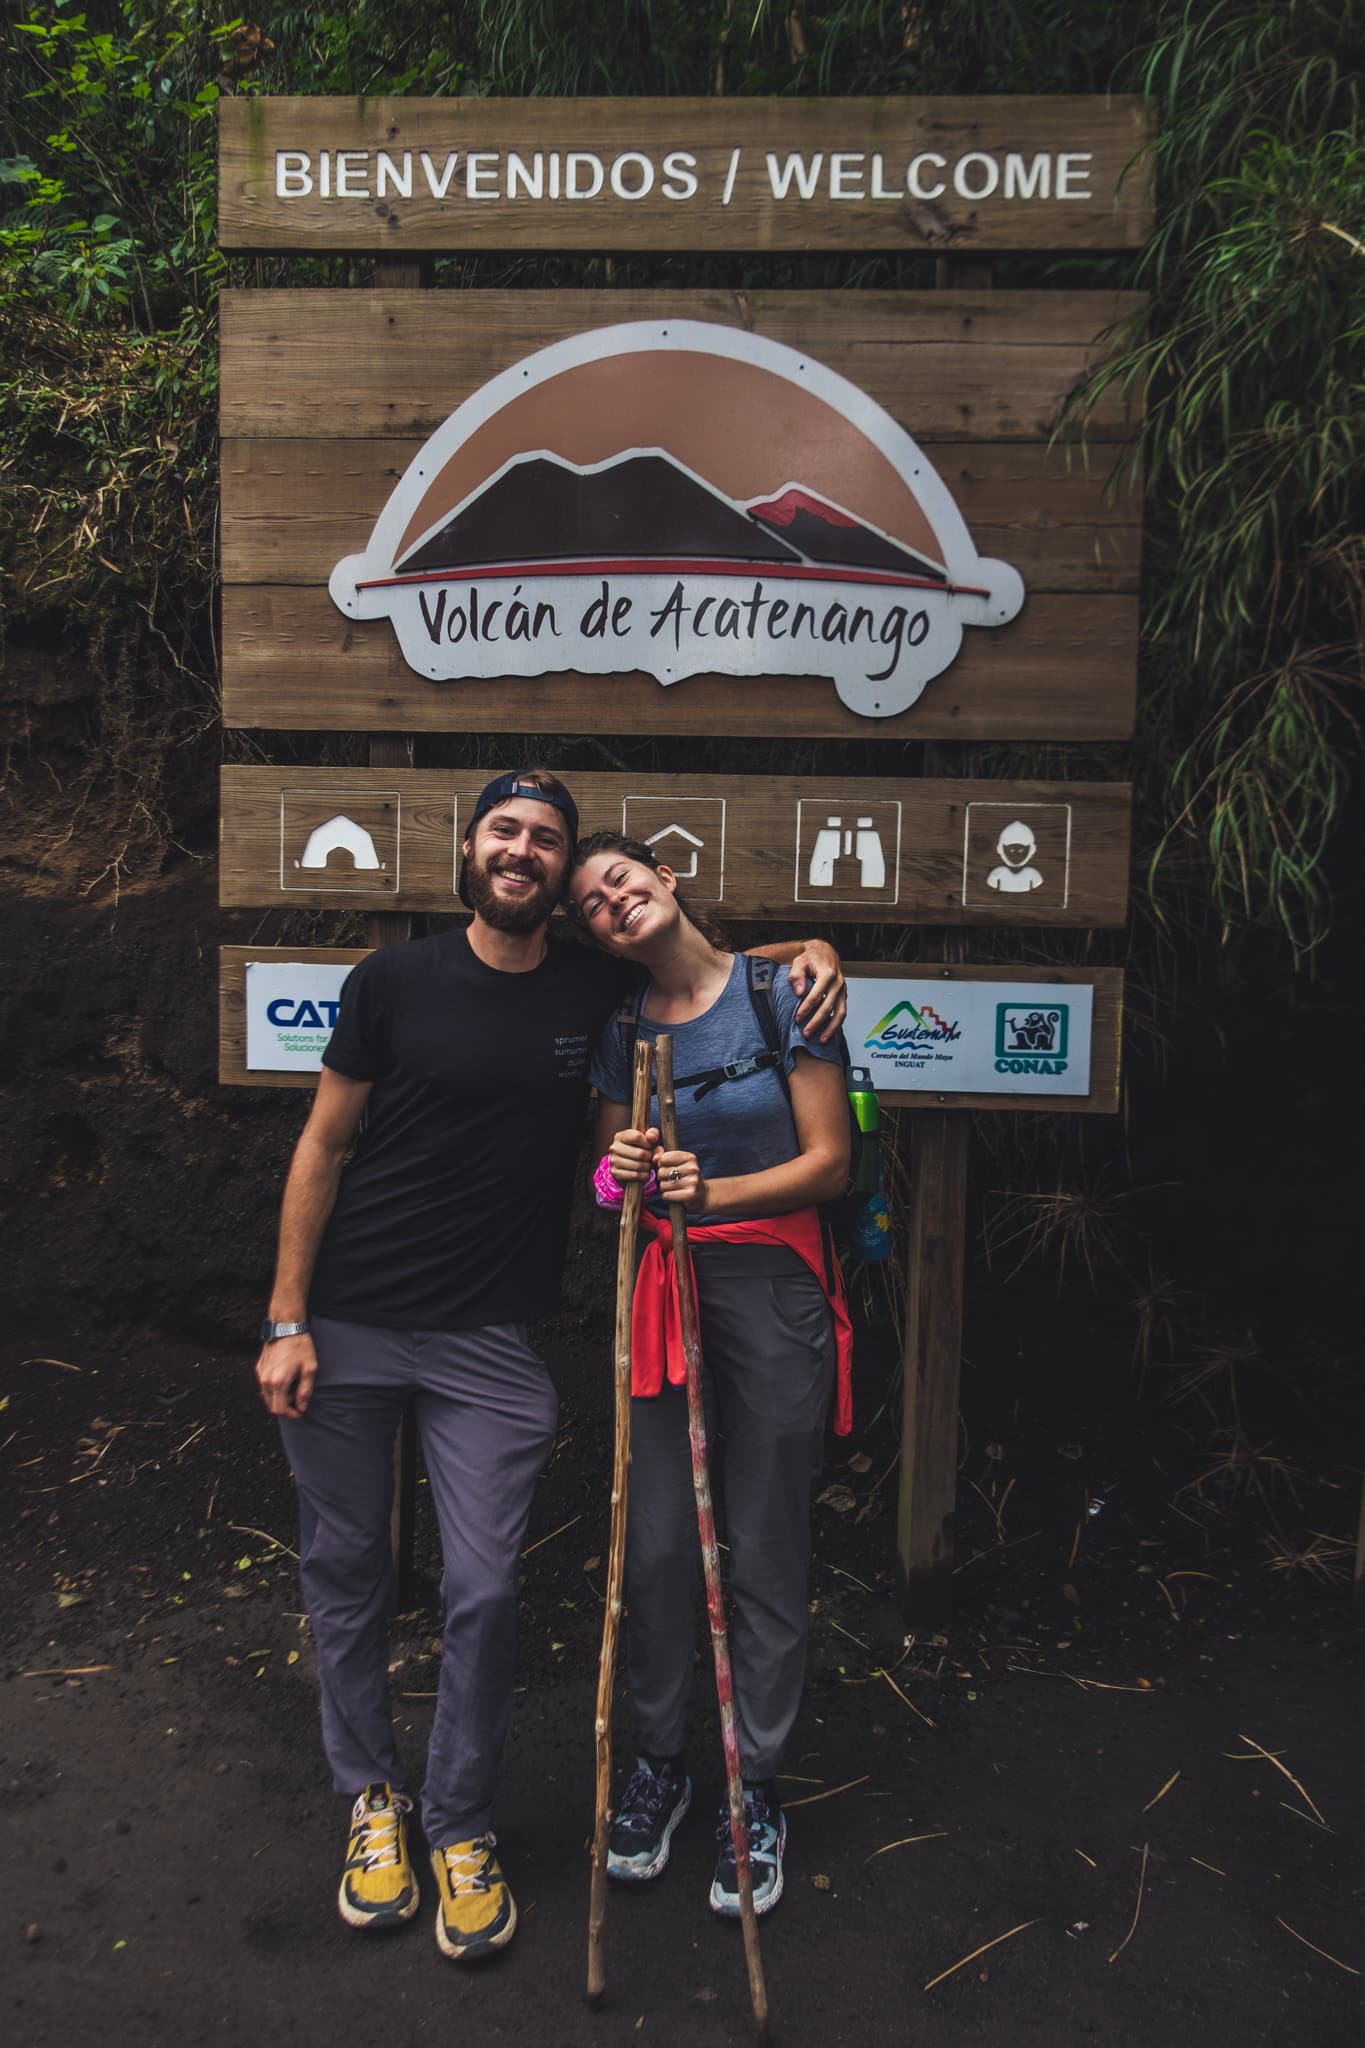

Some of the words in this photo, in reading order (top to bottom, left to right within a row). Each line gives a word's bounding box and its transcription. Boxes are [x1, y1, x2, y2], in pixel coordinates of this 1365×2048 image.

[276, 150, 698, 200] BIENVENIDOS
[722, 147, 741, 205] /
[766, 152, 1092, 200] WELCOME
[419, 584, 562, 645] Volcán
[580, 580, 632, 638] de
[650, 580, 930, 681] Acatenango
[277, 1033, 314, 1042] Solutions
[316, 1034, 328, 1043] for
[881, 1020, 962, 1043] Guatemala
[994, 1058, 1068, 1075] CONAP
